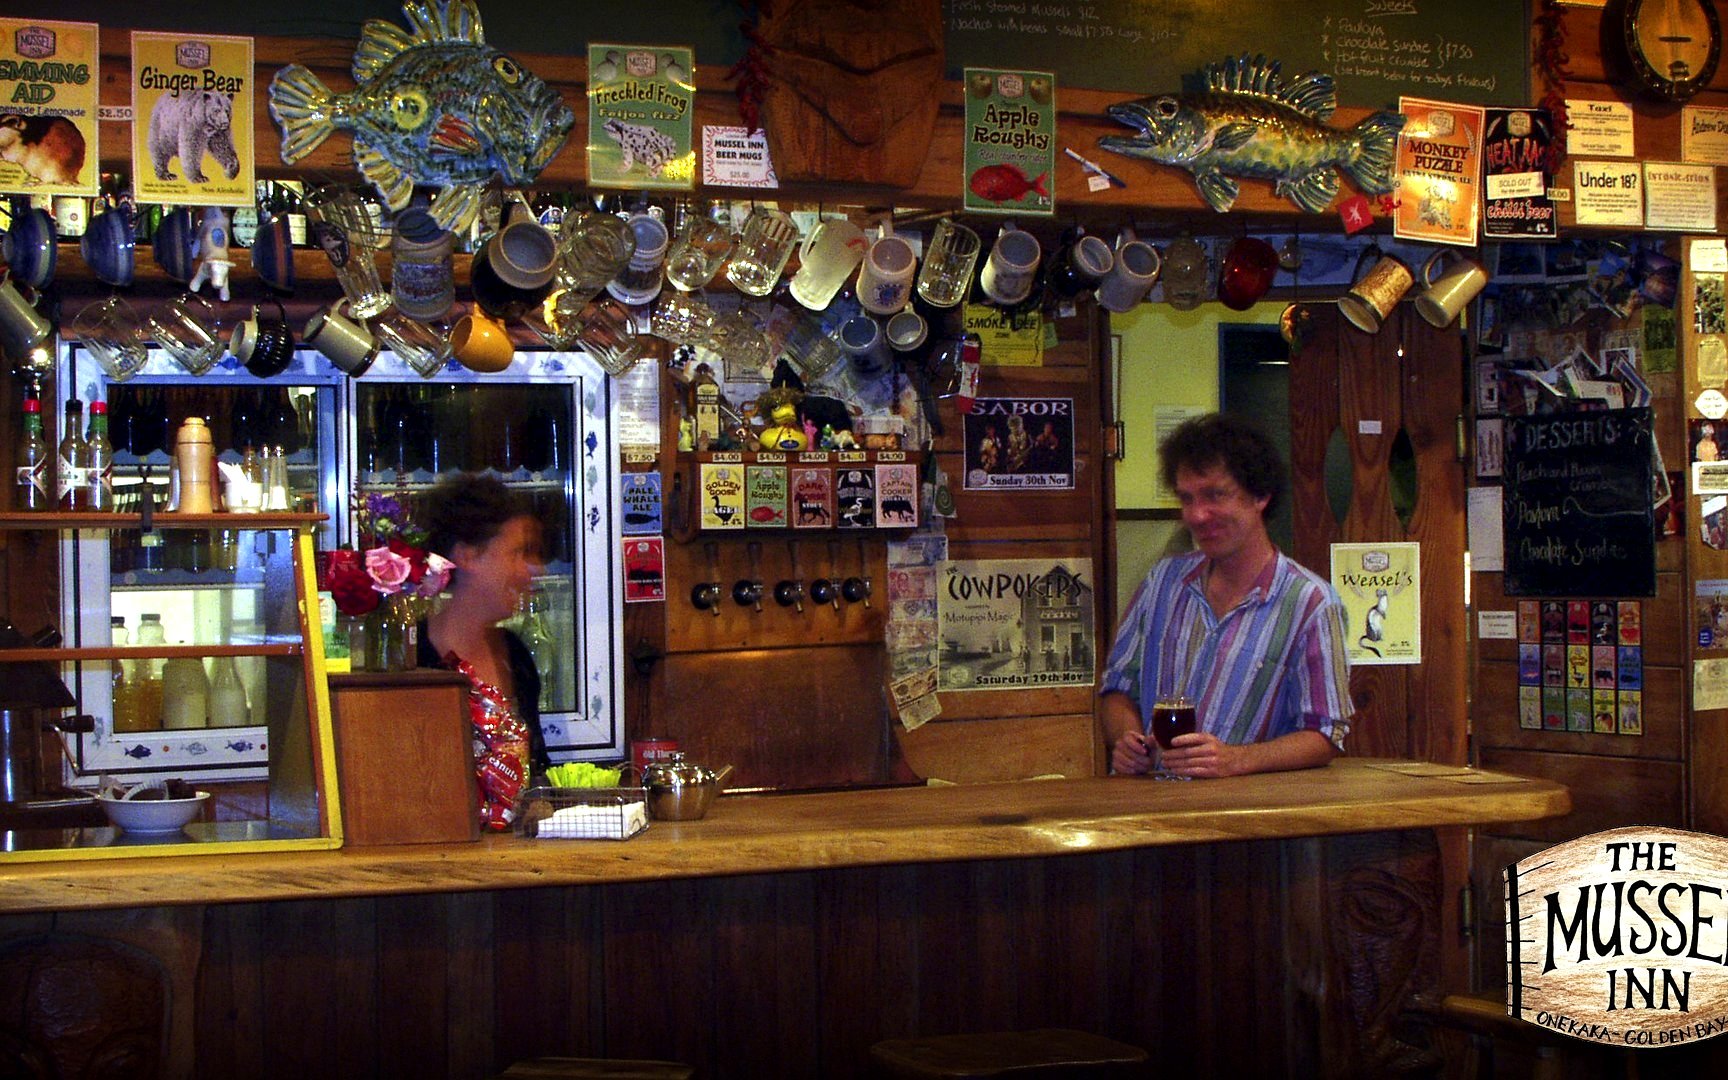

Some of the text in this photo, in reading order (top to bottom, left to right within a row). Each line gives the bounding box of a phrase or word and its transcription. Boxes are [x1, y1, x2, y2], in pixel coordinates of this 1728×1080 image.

[141, 67, 243, 98] Ginger Bear
[11, 82, 56, 104] AID
[596, 82, 688, 113] Freckled Frog
[37, 106, 85, 117] Lemonade
[98, 107, 131, 118] $2.50
[983, 103, 1041, 129] Apple
[973, 125, 1050, 150] Roughy
[714, 140, 764, 149] MUSSEL INN
[1409, 141, 1470, 160] MONKEY
[715, 151, 762, 160] BEER MUGS
[1414, 155, 1463, 174] PUZZLE
[1518, 178, 1531, 186] OUT
[1580, 171, 1637, 189] Under 18?
[966, 317, 1007, 329] SMOKE
[970, 401, 1068, 415] SABOR
[705, 480, 741, 491] GOLDEN
[755, 481, 780, 491] Apple
[798, 481, 824, 491] DARK
[990, 475, 1066, 486] Sunday 30th Nov
[623, 494, 660, 503] WHALE
[633, 503, 653, 511] ALE
[1340, 571, 1413, 586] Weasel's
[948, 573, 1082, 600] COWPOKERS
[976, 673, 1083, 685] Saturday 29th Nov
